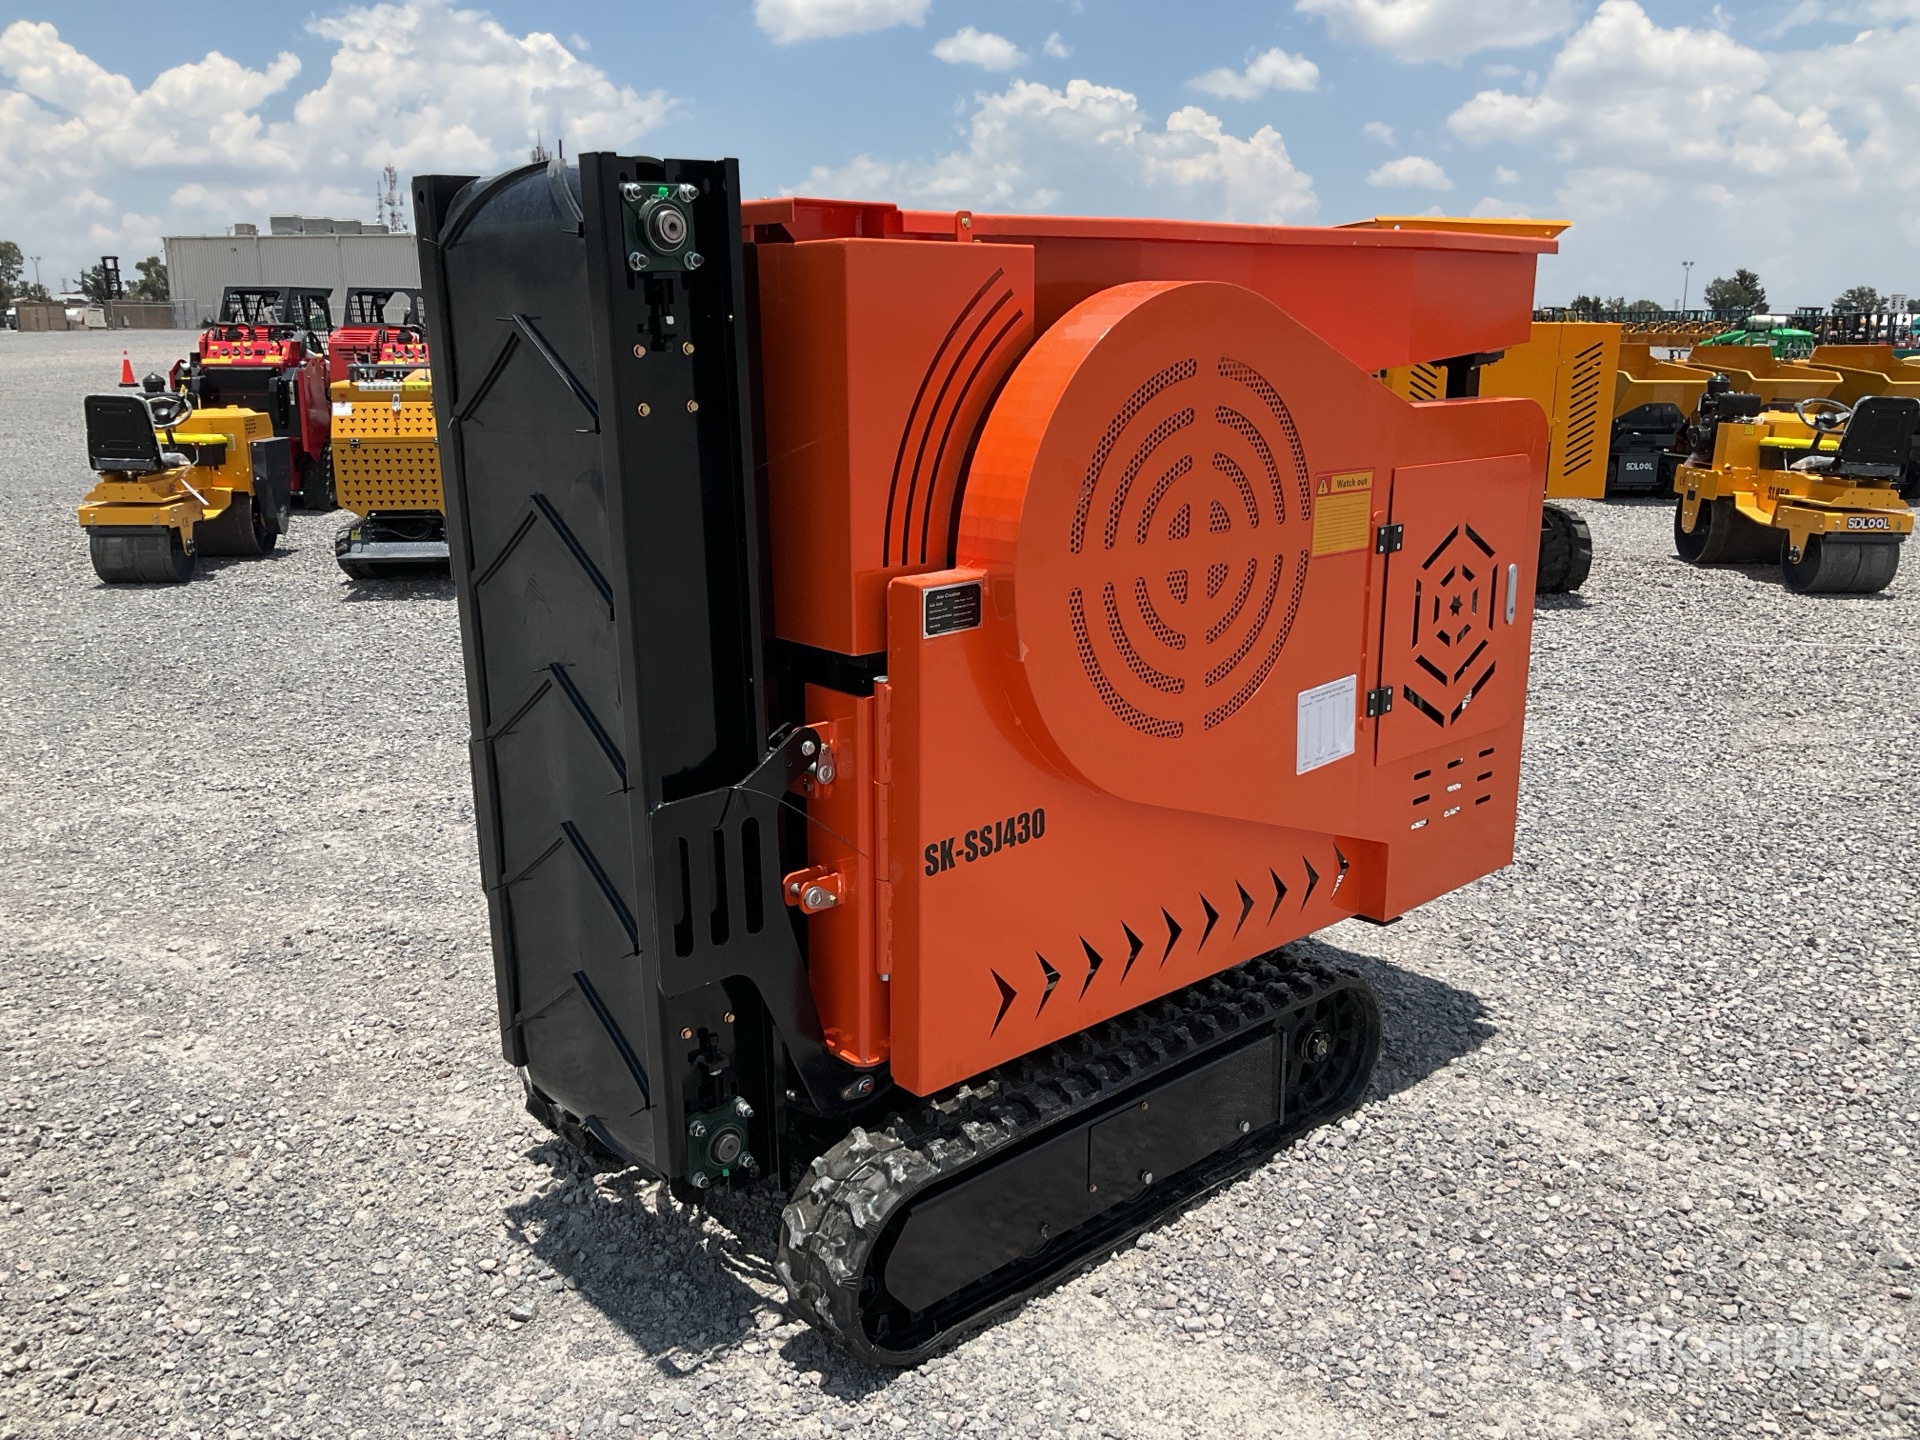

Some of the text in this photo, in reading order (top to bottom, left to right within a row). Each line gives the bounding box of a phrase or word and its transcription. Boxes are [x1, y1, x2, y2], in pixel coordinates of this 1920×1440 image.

[1626, 462, 1654, 470] SDLOOL
[1337, 478, 1368, 489] Watch out
[1847, 517, 1891, 531] SDLOOL
[924, 807, 1046, 877] SK-SSJ430
